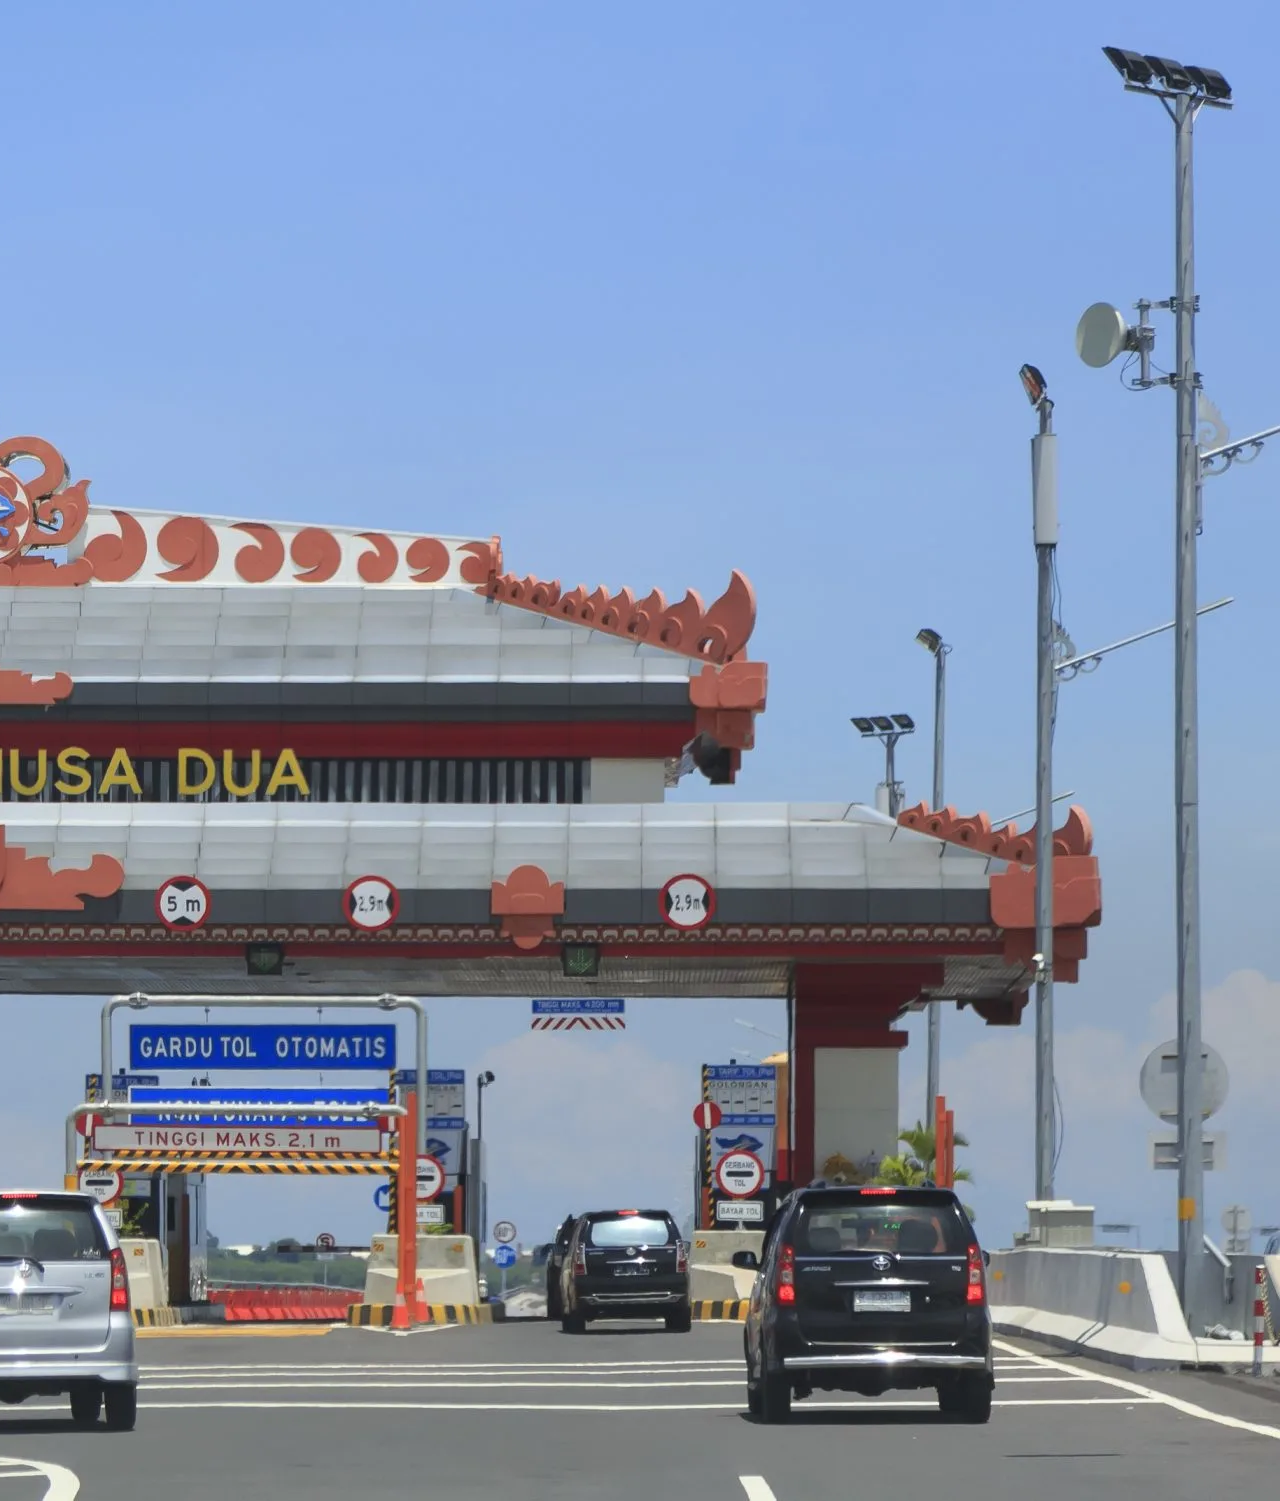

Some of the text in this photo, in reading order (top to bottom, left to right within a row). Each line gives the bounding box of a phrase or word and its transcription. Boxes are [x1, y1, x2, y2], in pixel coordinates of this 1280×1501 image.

[177, 747, 311, 798] DUA
[167, 895, 201, 912] 5 m
[140, 1036, 387, 1059] GARDU TOL OTOMATIS
[134, 1131, 206, 1147] TINGGI
[215, 1131, 281, 1147] MAKS.
[324, 1136, 341, 1148] m
[725, 1161, 755, 1169] GERBANG
[734, 1179, 746, 1187] TOL
[94, 1188, 106, 1196] TOL
[720, 1207, 759, 1215] BAYAR TOL
